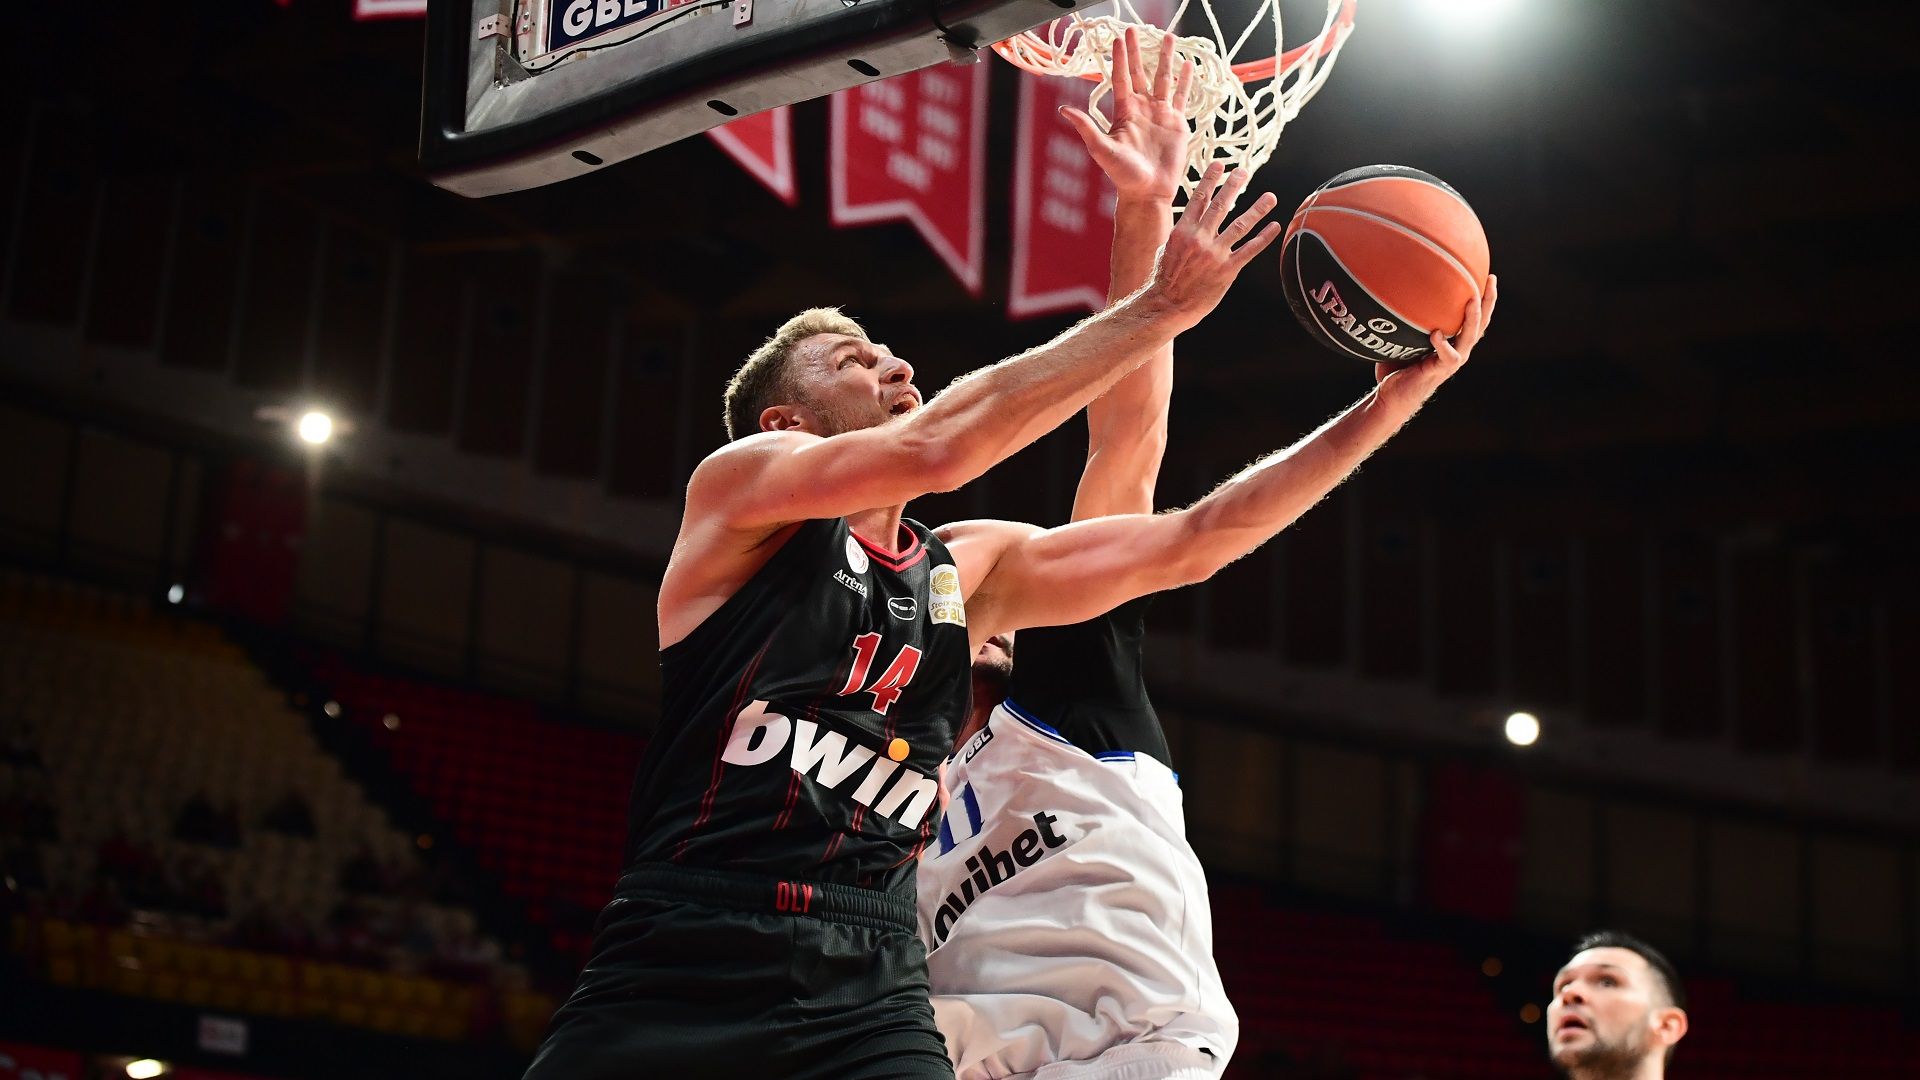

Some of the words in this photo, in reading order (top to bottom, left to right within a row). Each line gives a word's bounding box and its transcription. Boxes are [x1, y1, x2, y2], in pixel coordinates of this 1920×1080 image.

[837, 631, 922, 715] 14
[721, 699, 938, 830] bwin
[776, 881, 813, 913] OLY
[932, 811, 1067, 951] ovibet
